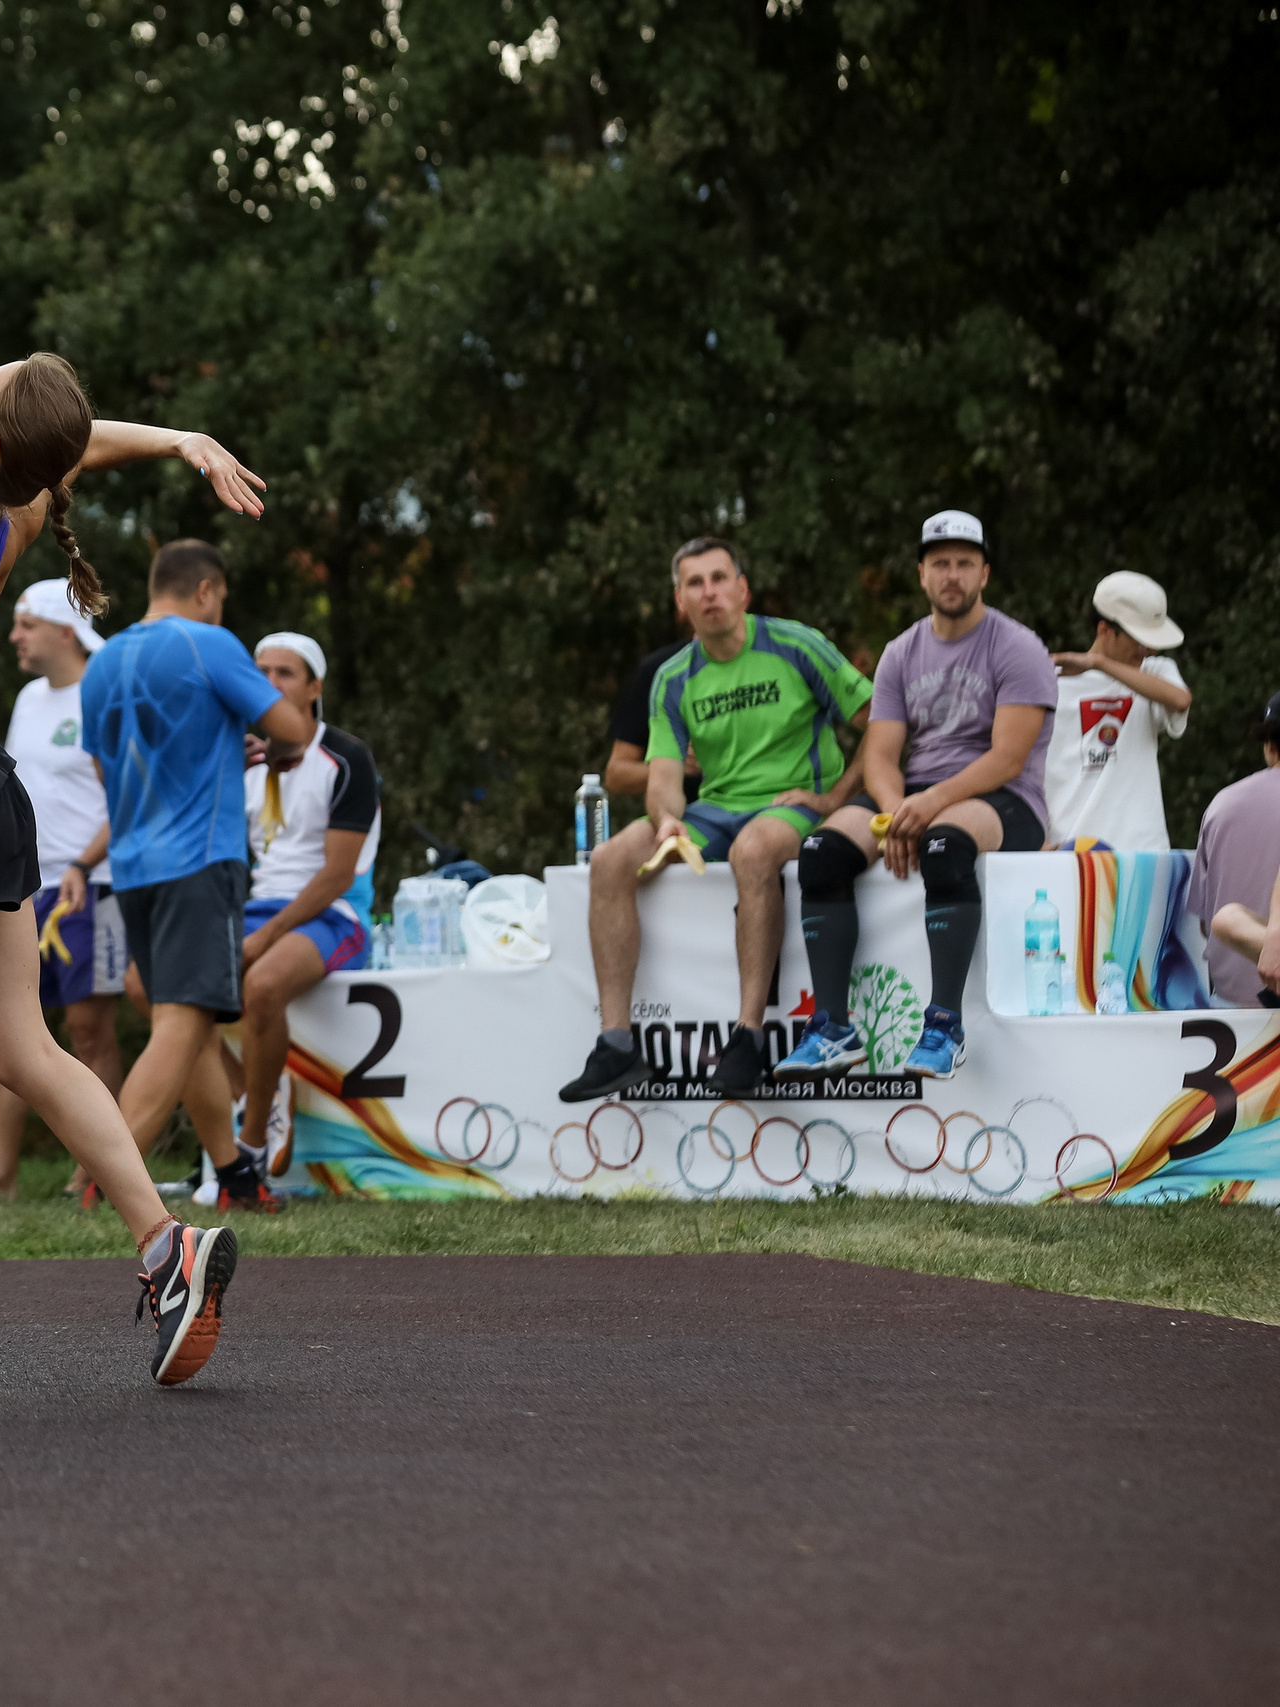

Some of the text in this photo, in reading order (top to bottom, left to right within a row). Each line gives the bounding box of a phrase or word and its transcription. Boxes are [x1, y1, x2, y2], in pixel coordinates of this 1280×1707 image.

[716, 690, 780, 715] CONTACT
[632, 999, 672, 1018] сёлок
[342, 983, 407, 1098] 2
[626, 1080, 678, 1099] Моя
[823, 1077, 917, 1098] Москва
[1168, 1019, 1238, 1160] 3
